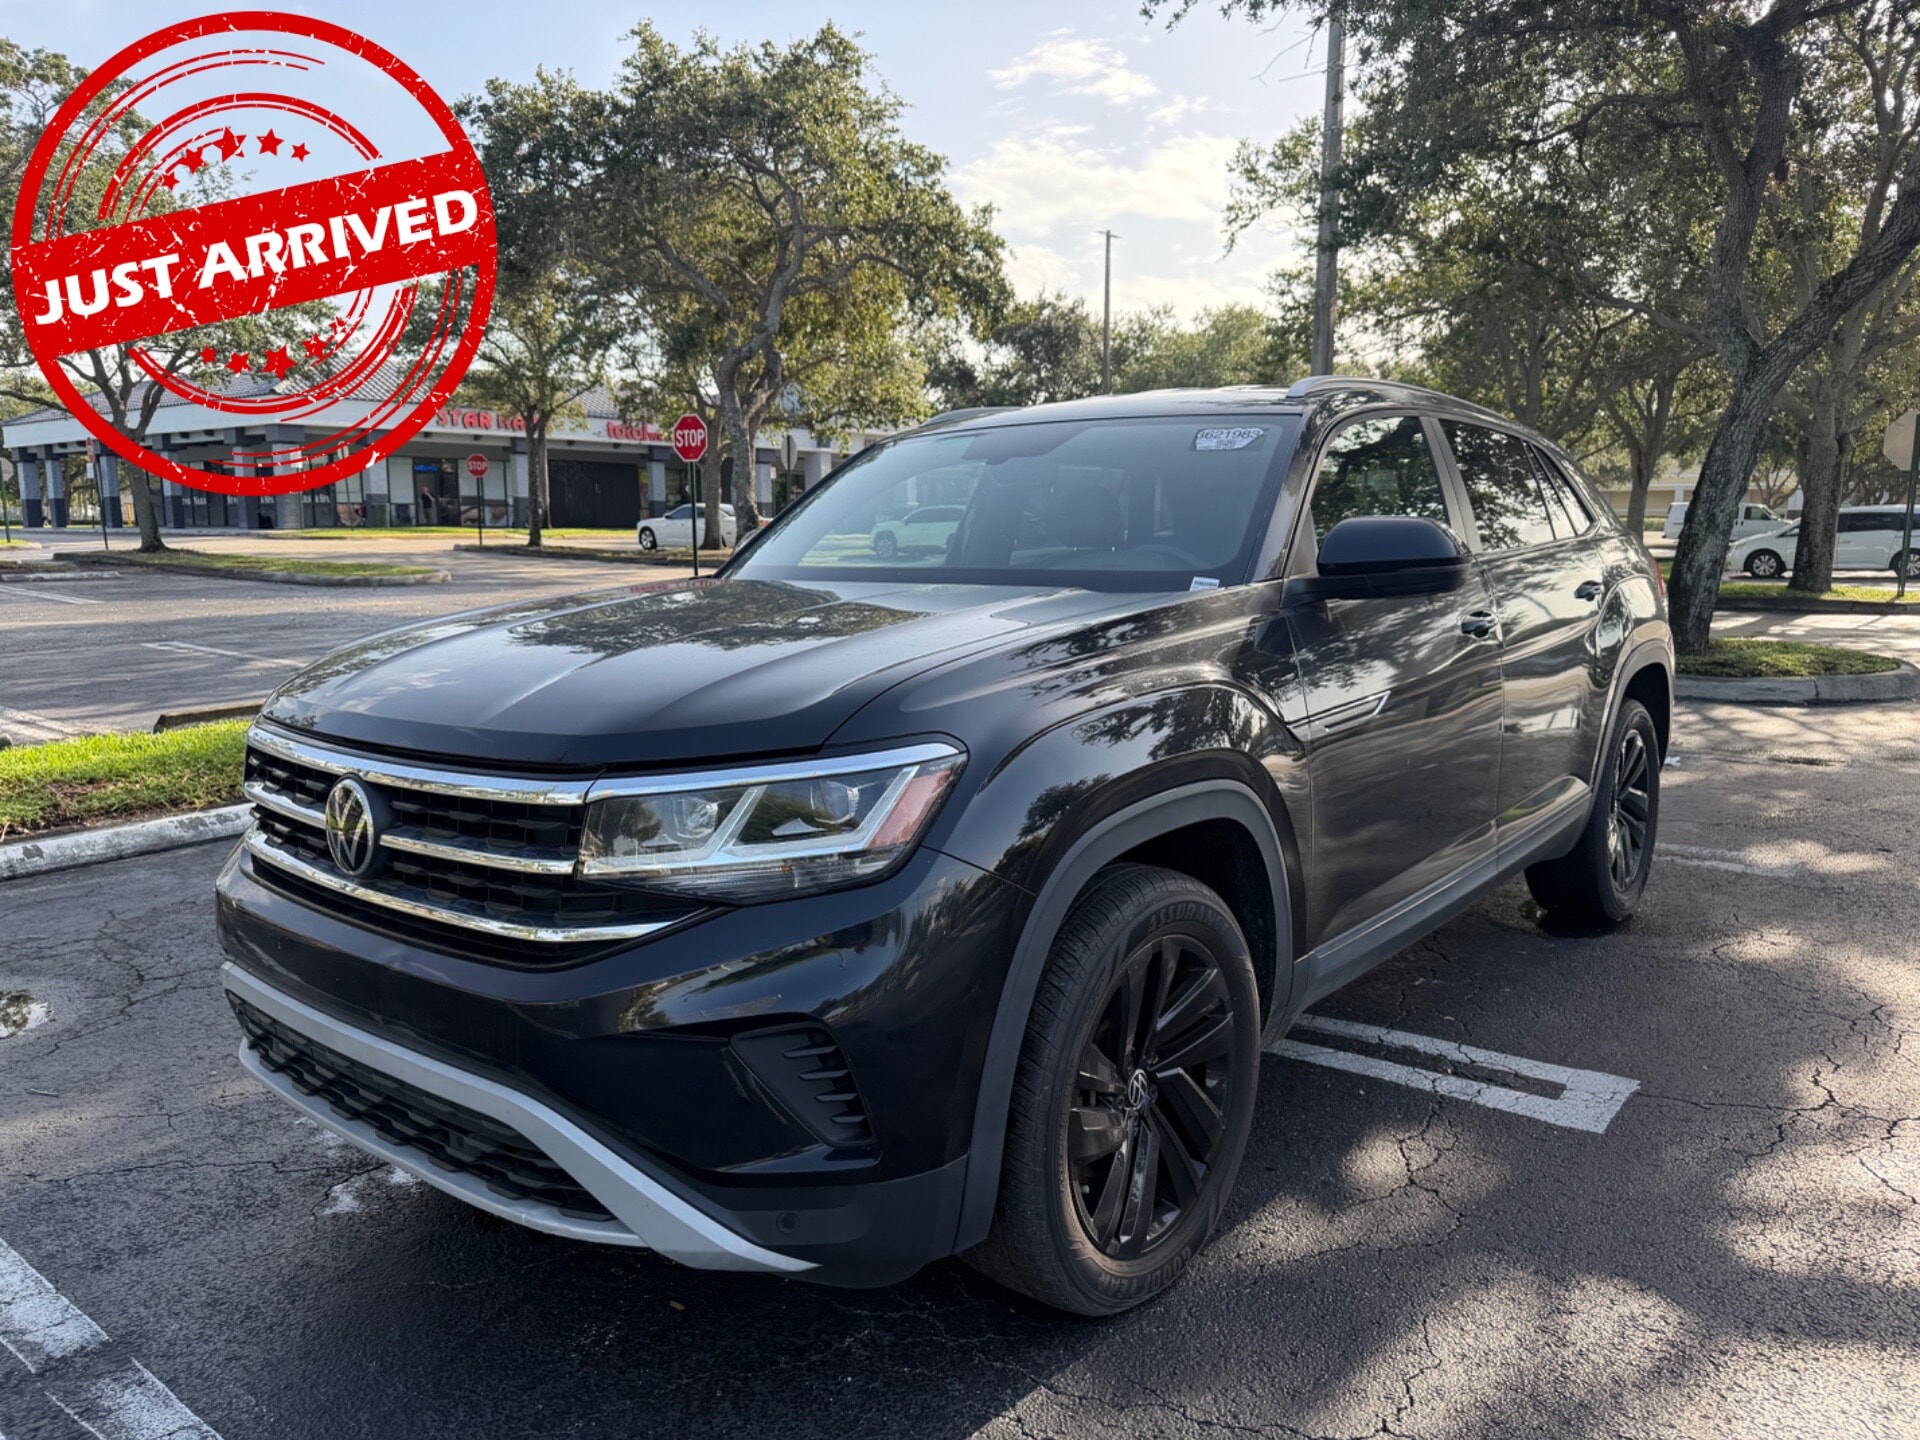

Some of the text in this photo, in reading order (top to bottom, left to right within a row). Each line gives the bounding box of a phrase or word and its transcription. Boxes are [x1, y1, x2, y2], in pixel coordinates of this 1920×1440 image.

[437, 409, 493, 429] STAR
[675, 429, 705, 448] STOP
[467, 460, 488, 471] STOP
